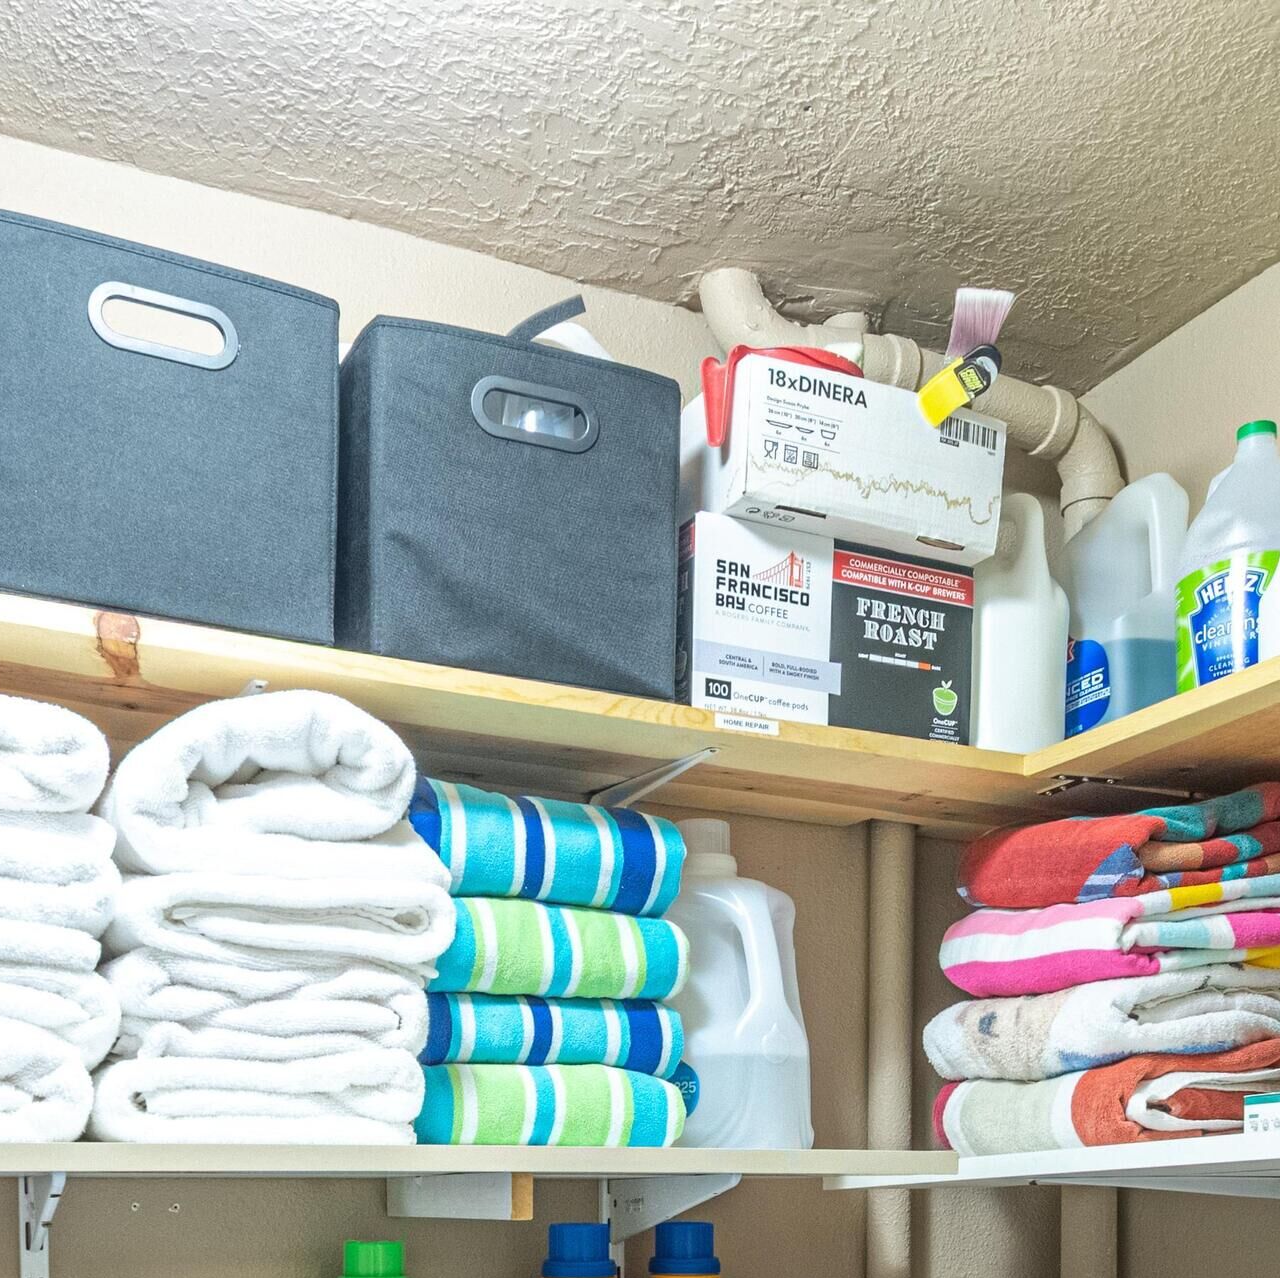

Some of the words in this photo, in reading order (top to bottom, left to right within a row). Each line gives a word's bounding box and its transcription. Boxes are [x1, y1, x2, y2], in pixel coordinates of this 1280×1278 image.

[767, 368, 868, 409] 18xDINERA
[716, 559, 750, 578] SAN
[841, 569, 886, 585] COMPATIBLE
[888, 579, 907, 589] WITH
[849, 558, 907, 576] COMMERCIALLY
[716, 576, 810, 607] FRANCISCO
[715, 593, 745, 611] BAY
[748, 603, 789, 619] COFFEE
[856, 597, 945, 632] FRENCH
[863, 620, 937, 651] ROAST
[708, 682, 729, 697] 100
[768, 698, 791, 708] coffee
[792, 703, 809, 711] pods
[723, 719, 743, 727] HOME
[745, 721, 769, 730] REPAIR
